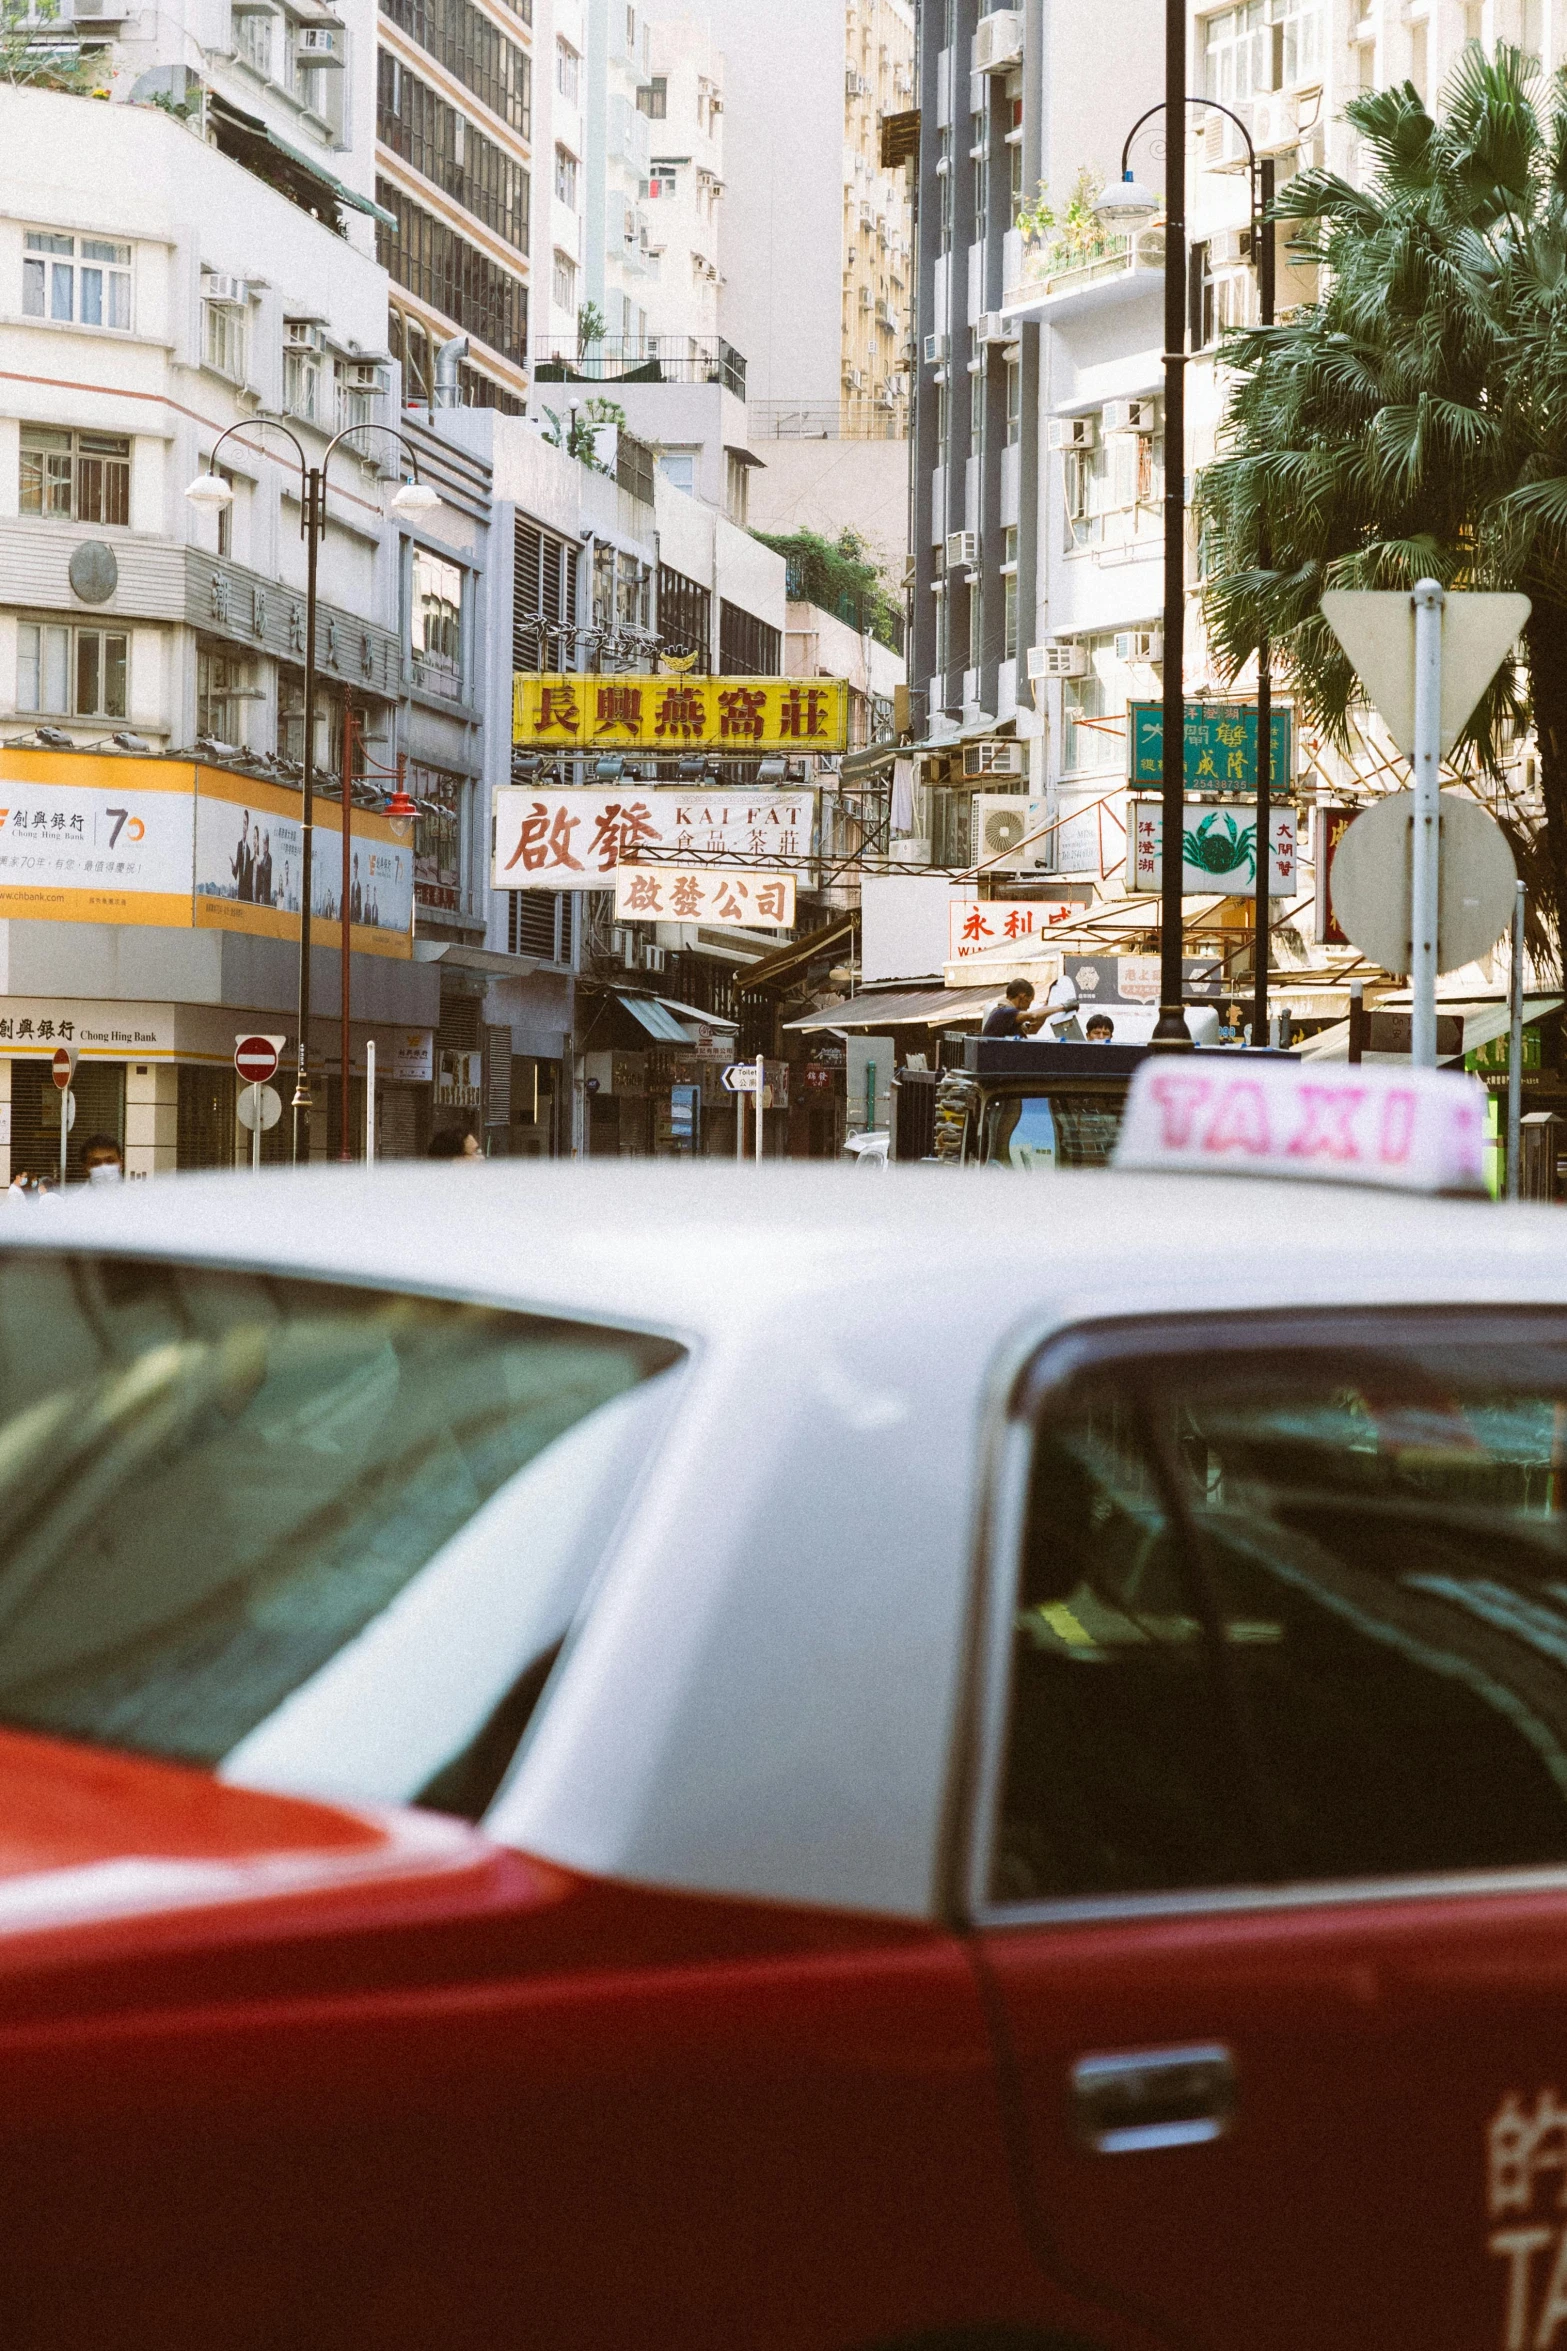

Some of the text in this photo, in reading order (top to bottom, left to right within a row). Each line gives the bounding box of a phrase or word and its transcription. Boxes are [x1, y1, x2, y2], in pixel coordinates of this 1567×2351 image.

[532, 685, 829, 738] 長興燕窩莊
[12, 809, 86, 833] 創興銀行
[675, 807, 802, 825] KAI FAT
[12, 829, 85, 842] Chong Hing Bank
[1138, 821, 1156, 874] 洋澄湖
[623, 874, 787, 922] 啟發公司
[0, 1018, 75, 1042] 創興銀行
[80, 1030, 157, 1043] Chong Hing Bank
[738, 1068, 757, 1076] Toilet
[1150, 1074, 1417, 1164] TAXI
